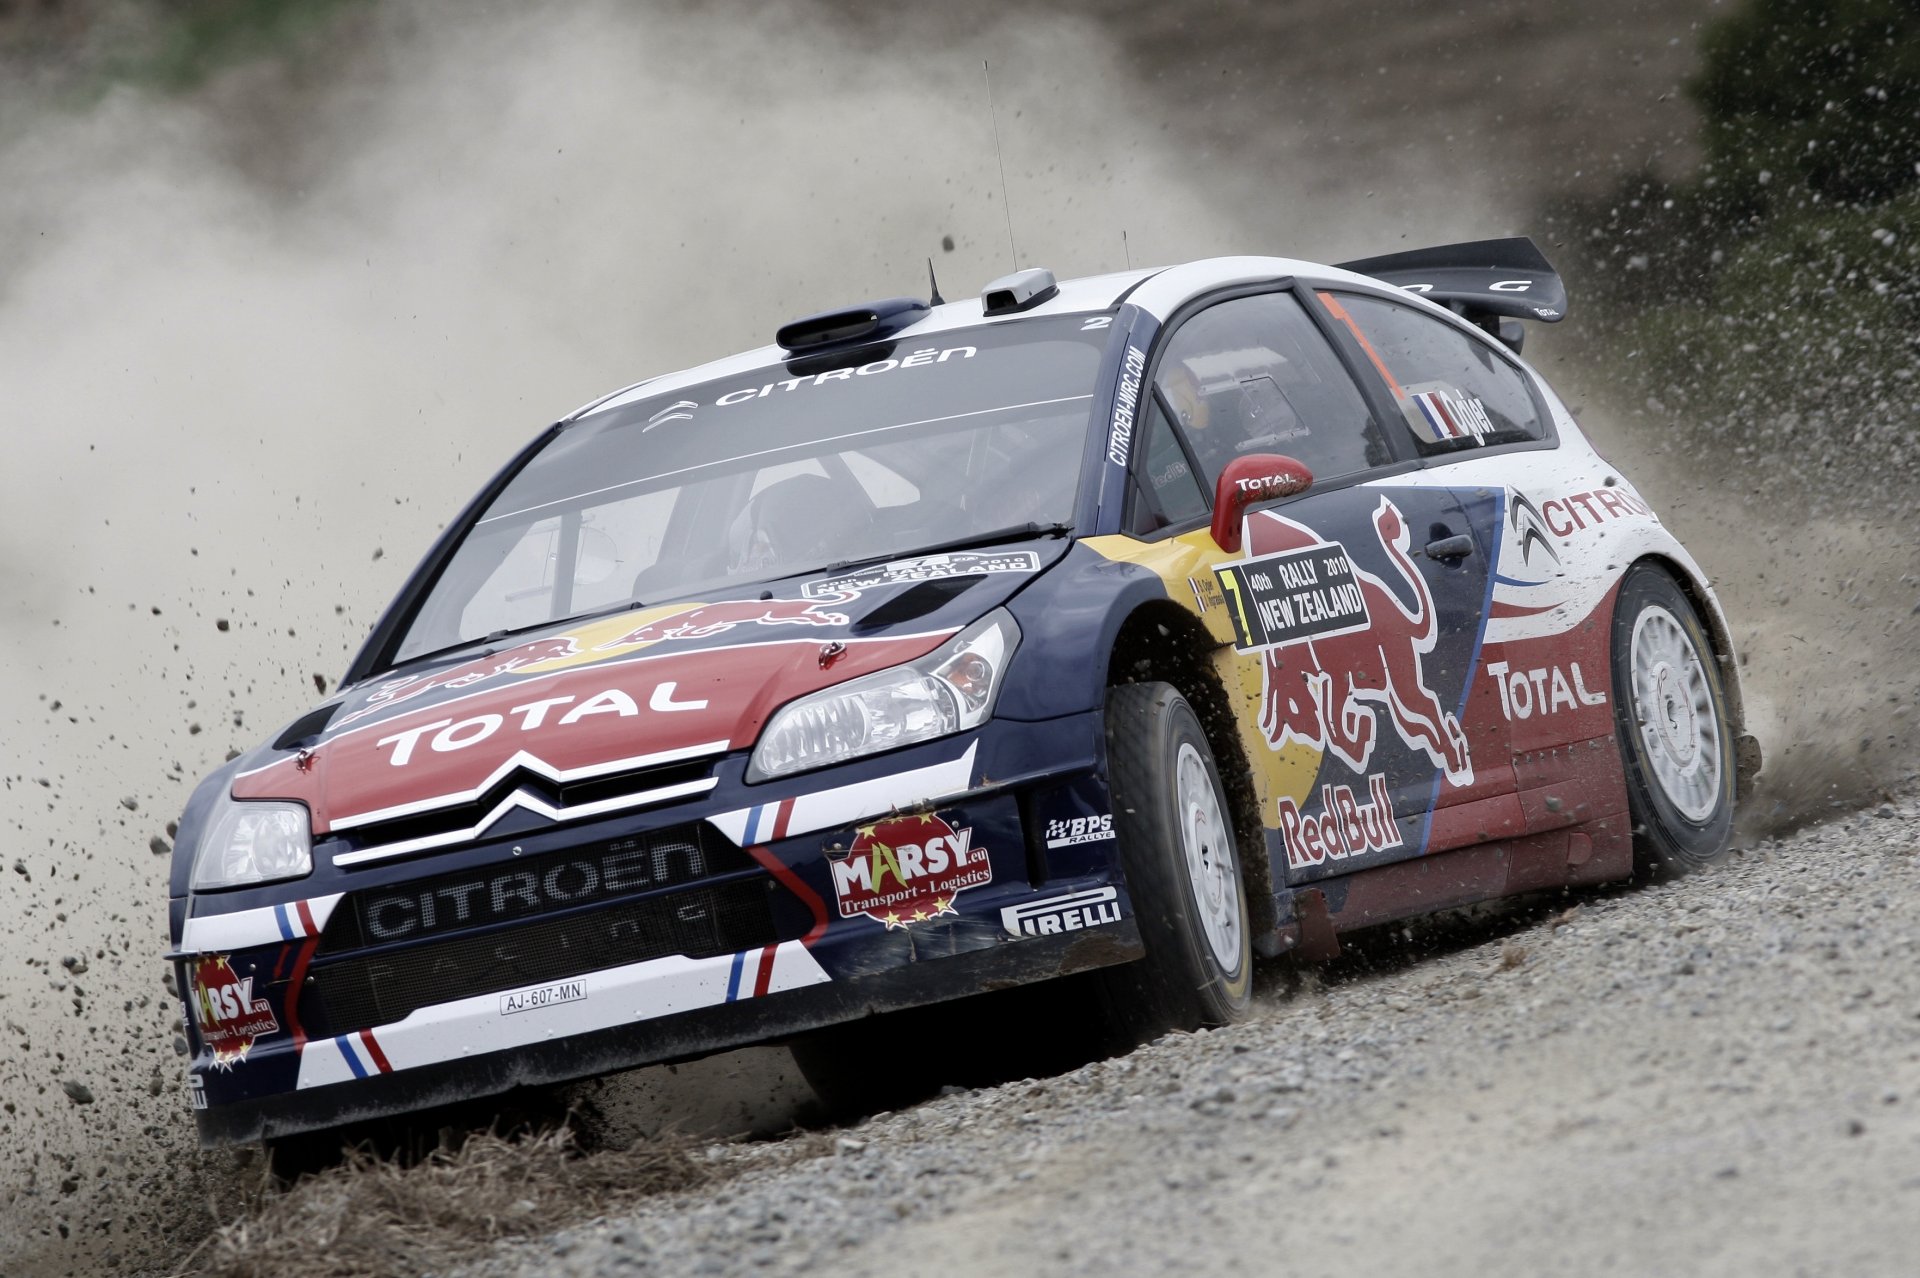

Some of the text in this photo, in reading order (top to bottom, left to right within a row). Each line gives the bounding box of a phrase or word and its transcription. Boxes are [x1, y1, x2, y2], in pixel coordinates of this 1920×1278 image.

[1109, 345, 1146, 467] CITROEN-WRC.COM
[1439, 388, 1496, 447] Ogier
[1235, 473, 1297, 492] TOTAL
[1542, 487, 1655, 537] CITRO
[816, 577, 881, 595] NEW
[889, 560, 1028, 582] ZEALAND
[882, 562, 957, 578] RALLY
[980, 557, 1025, 565] 2010
[1250, 555, 1349, 593] 40th RALLY 2010
[1219, 569, 1253, 646] 7
[1258, 582, 1363, 632] NEW ZEALAND
[1487, 661, 1606, 722] TOTAL
[376, 681, 709, 766] TOTAL
[1068, 831, 1112, 844] RALLYE
[1070, 814, 1113, 837] BPS
[841, 885, 918, 914] Transport
[929, 869, 990, 895] Logistics
[1000, 886, 1122, 937] PIRELLI
[507, 983, 581, 1011] AJ-607-MN
[233, 1017, 278, 1037] Logistics
